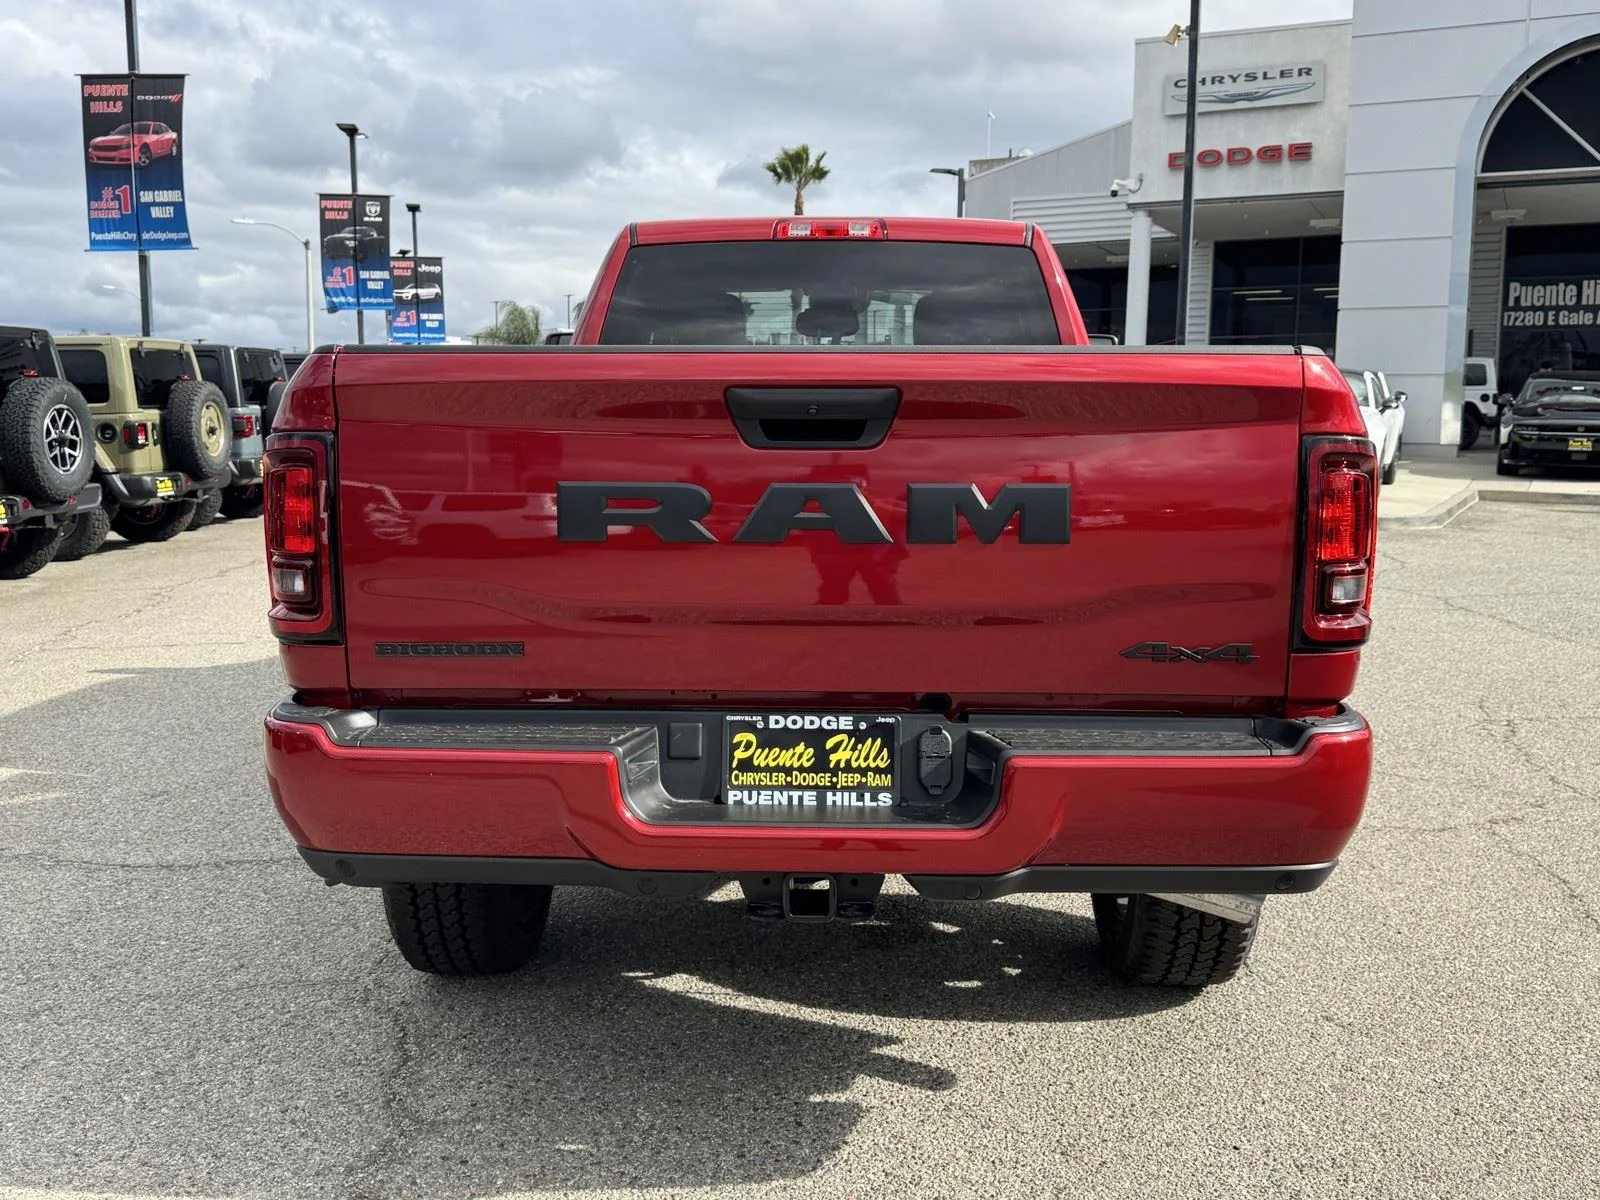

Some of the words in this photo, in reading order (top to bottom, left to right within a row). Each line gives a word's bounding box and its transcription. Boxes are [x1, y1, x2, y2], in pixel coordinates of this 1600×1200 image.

[84, 84, 128, 96] PUENTE
[90, 100, 123, 113] HILLS
[1168, 142, 1313, 168] DODGE
[140, 190, 154, 202] SAN
[154, 190, 182, 202] GABRIEL
[150, 206, 174, 218] VALLEY
[418, 264, 442, 274] Jeep
[1508, 282, 1578, 306] Puente
[1504, 310, 1544, 326] 17280
[1547, 310, 1556, 326] E
[1559, 310, 1594, 326] Gale
[556, 481, 1071, 544] RAM
[376, 642, 524, 657] BIGHORN
[769, 716, 854, 730] DODGE
[732, 732, 815, 769] Puente
[826, 734, 891, 769] Hills
[728, 791, 817, 805] PUENTE
[826, 791, 893, 807] HILLS
